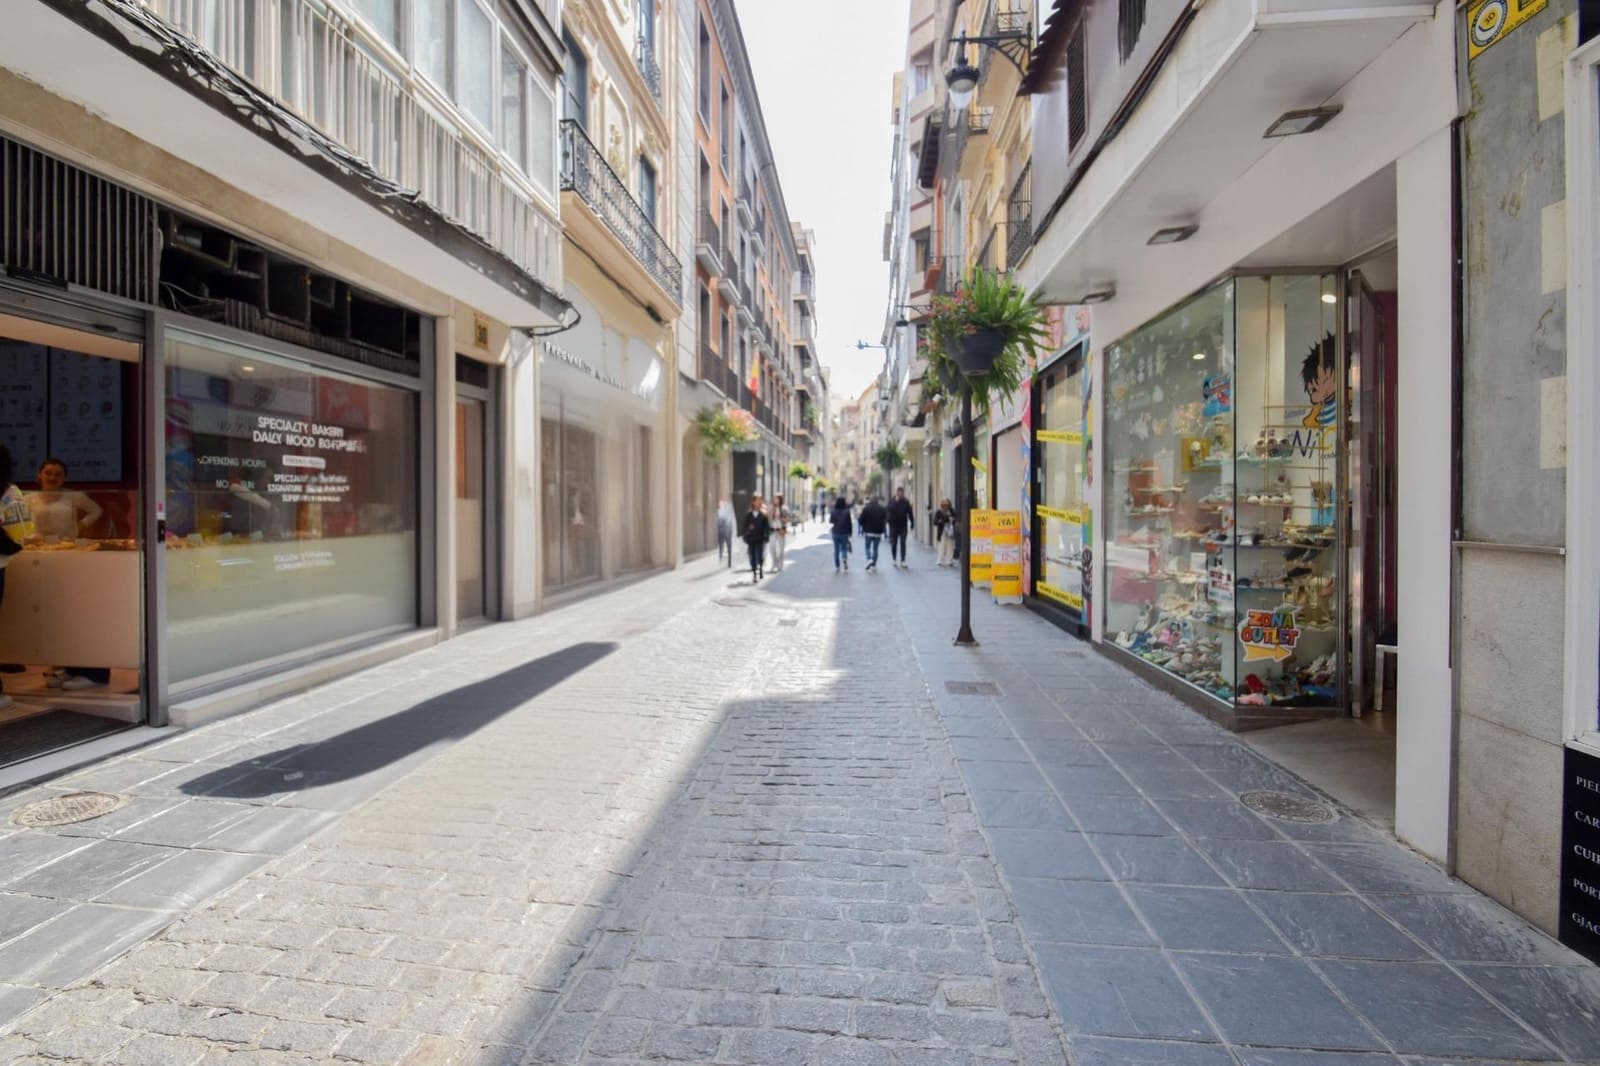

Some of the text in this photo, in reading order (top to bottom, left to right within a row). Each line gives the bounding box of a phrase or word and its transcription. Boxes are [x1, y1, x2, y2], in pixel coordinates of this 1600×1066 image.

[258, 416, 344, 437] SPECIALTY BAKERY
[252, 430, 282, 445] DAILY
[286, 434, 315, 448] MOOD
[202, 455, 267, 469] OPENING HOURS
[1247, 610, 1295, 629] ZONA
[1240, 627, 1299, 647] OUTLET
